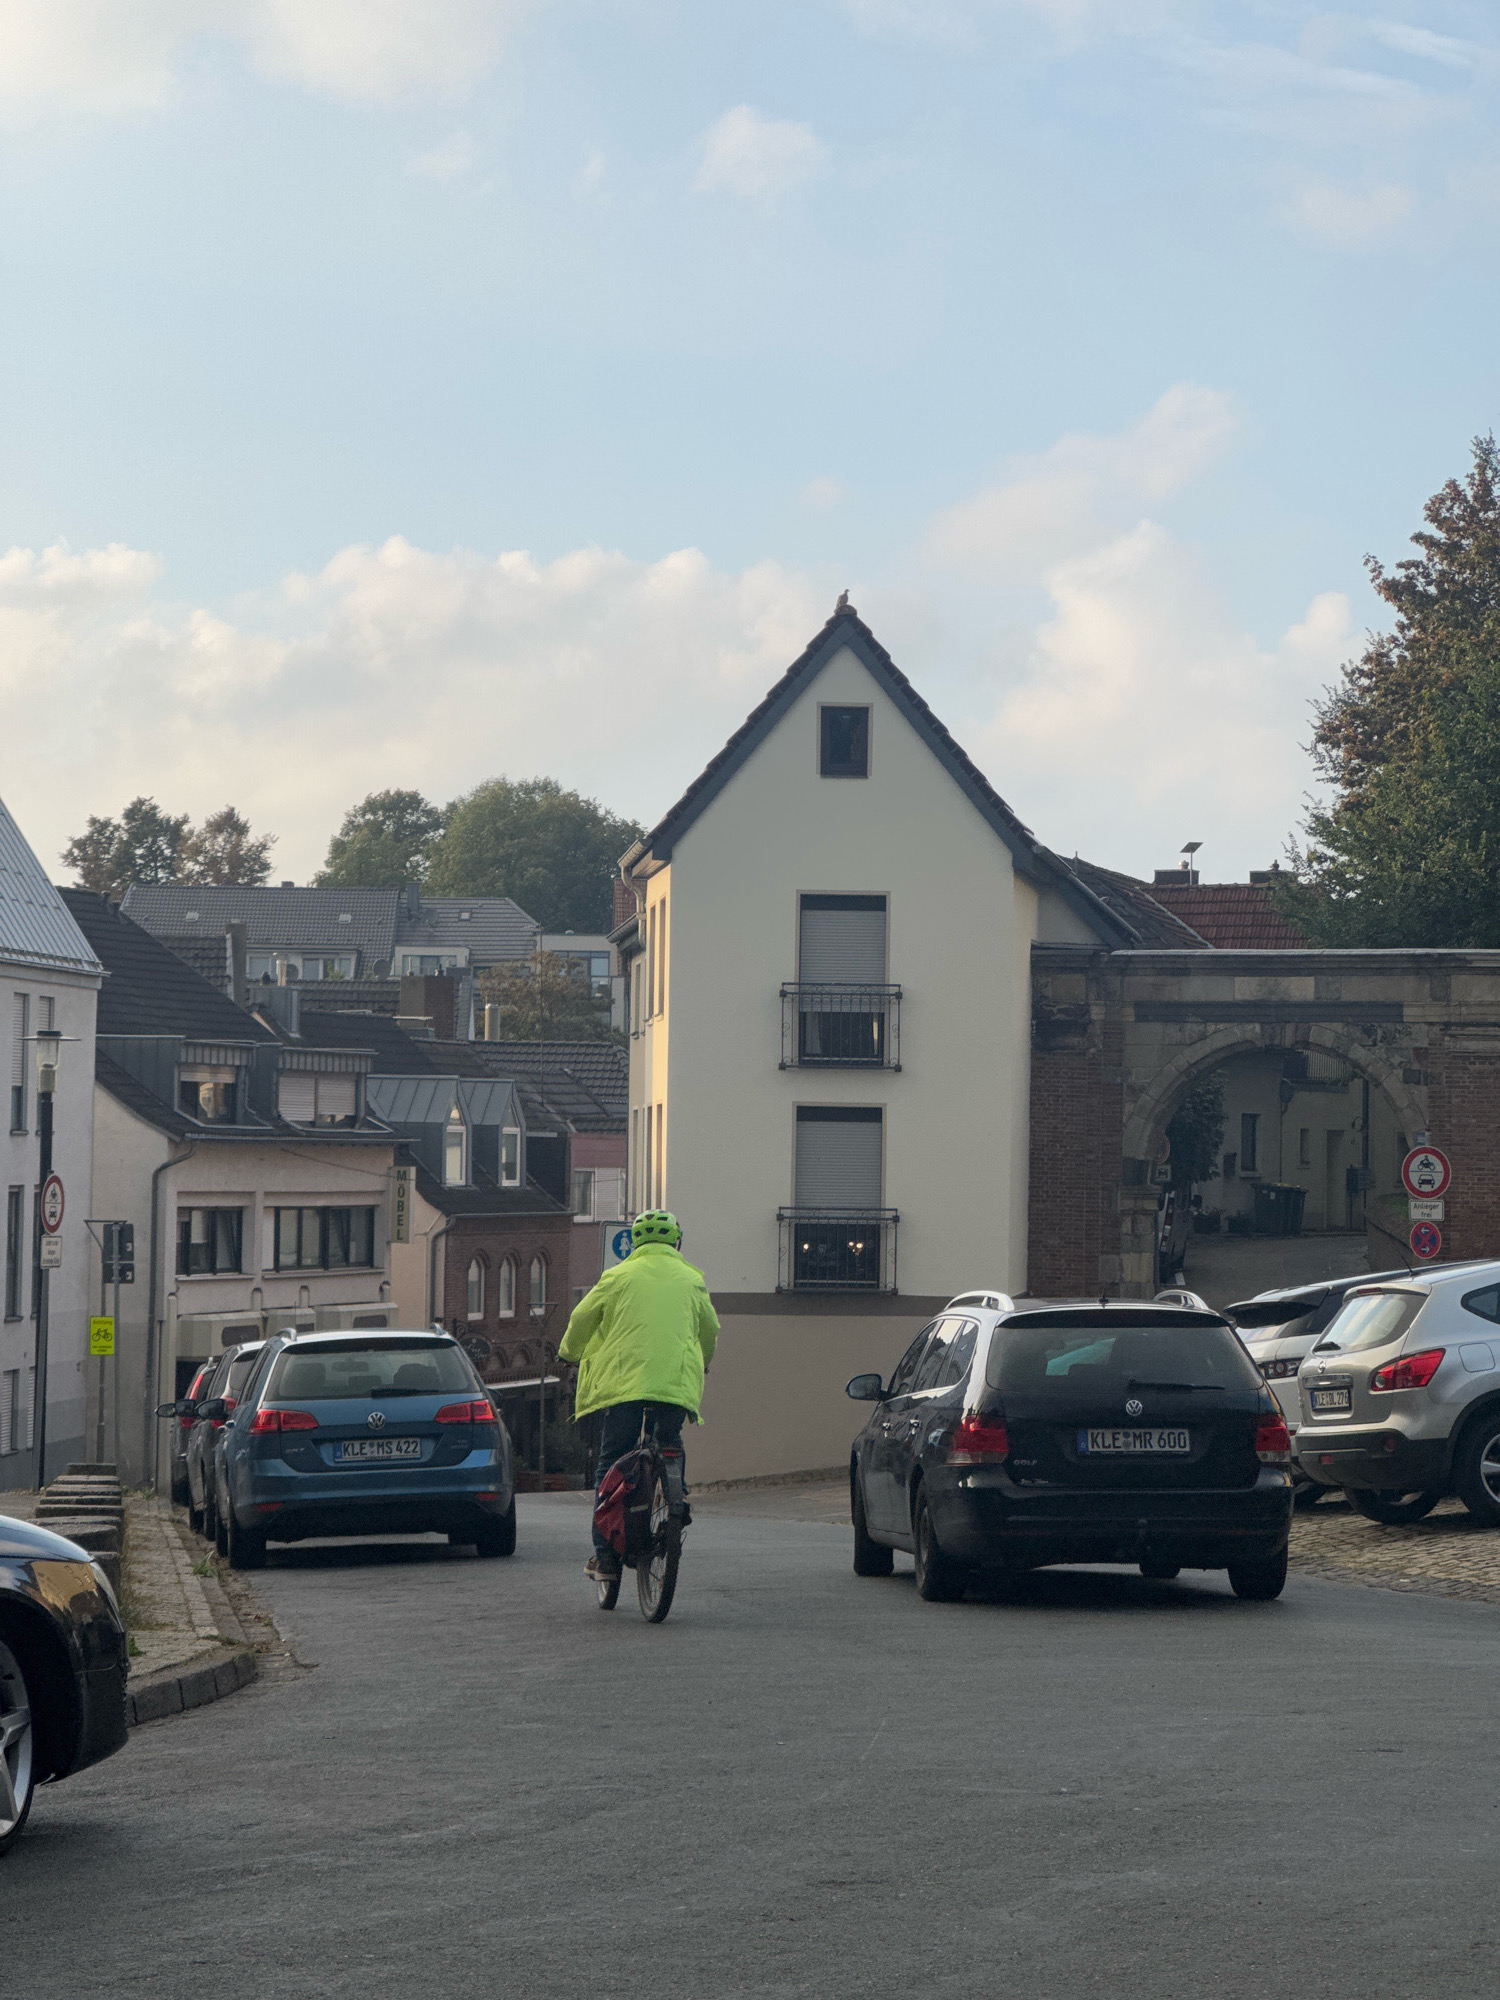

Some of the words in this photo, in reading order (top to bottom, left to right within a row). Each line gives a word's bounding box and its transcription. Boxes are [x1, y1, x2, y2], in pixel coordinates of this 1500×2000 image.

[396, 1169, 407, 1241] MÖBEL
[1413, 1202, 1440, 1211] Anlieger
[343, 1442, 367, 1457] KLE
[376, 1440, 393, 1455] MS
[395, 1440, 419, 1454] 422
[1090, 1431, 1121, 1449] KLE
[1132, 1431, 1154, 1449] MR
[1157, 1431, 1187, 1449] 600
